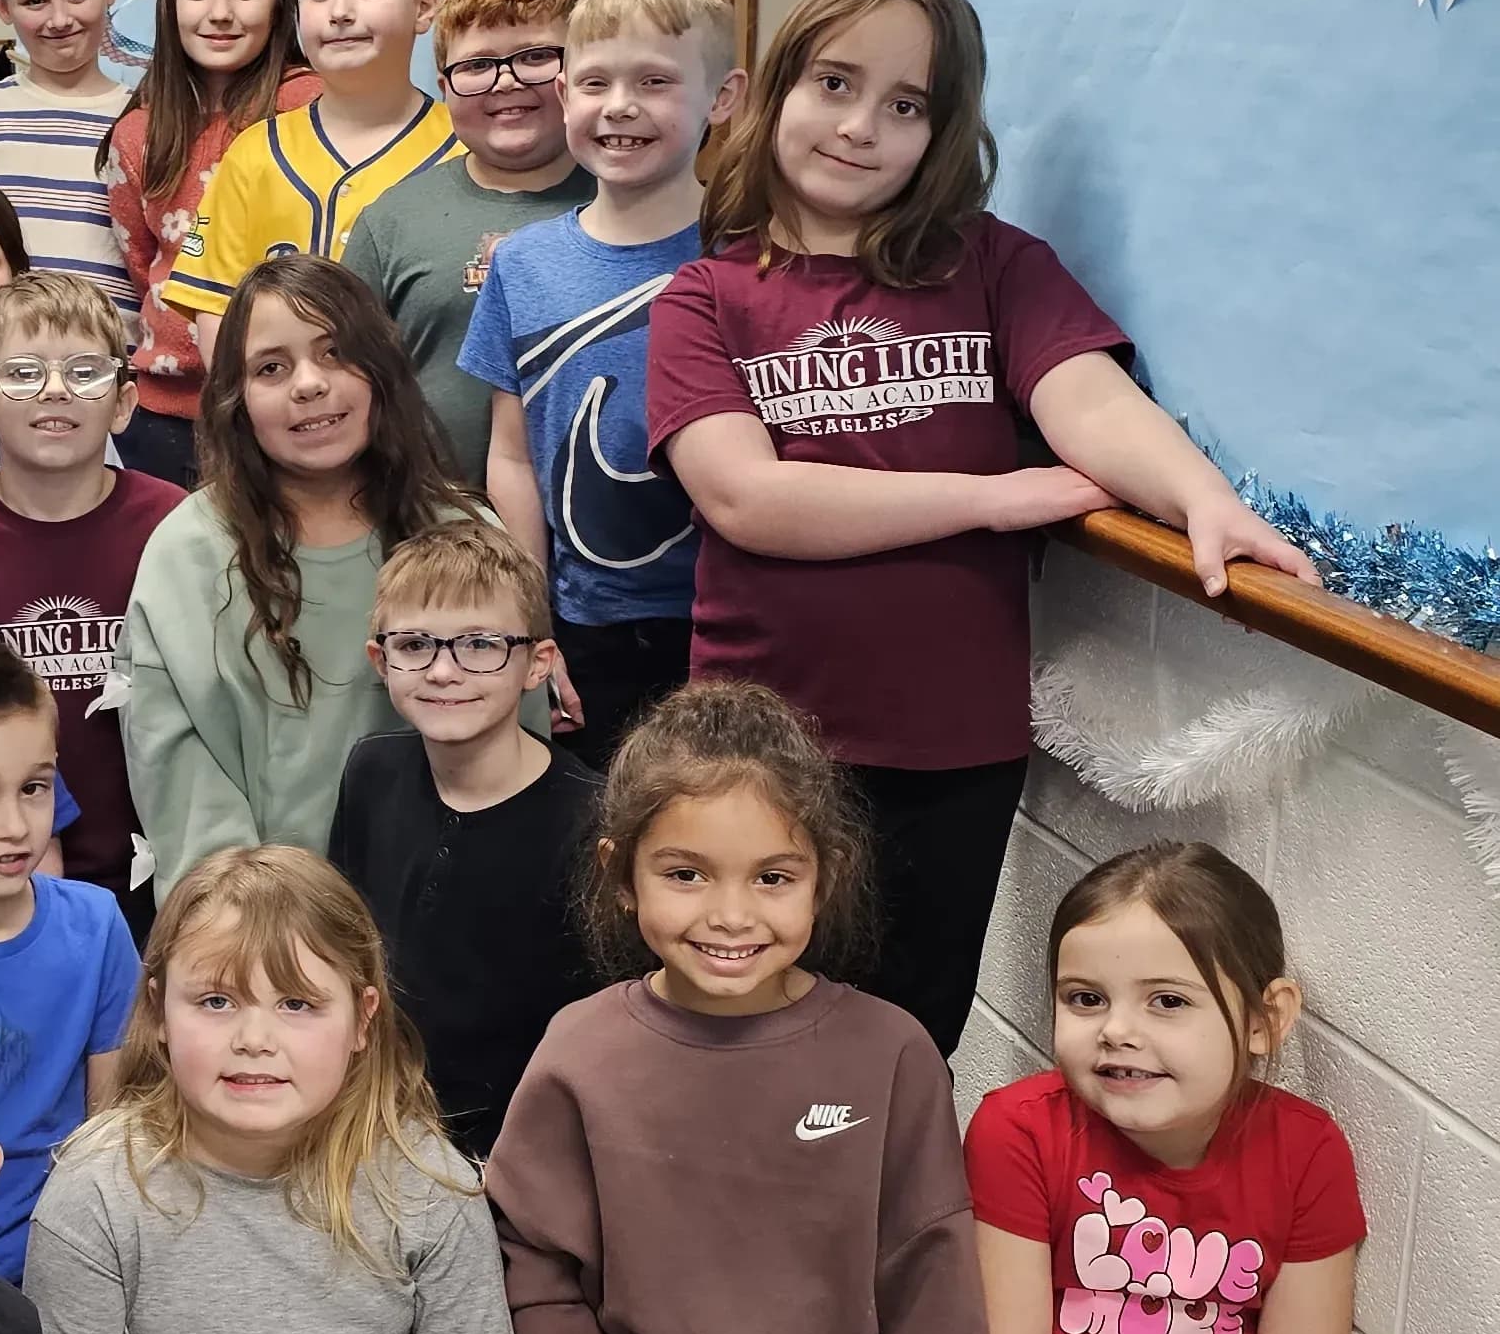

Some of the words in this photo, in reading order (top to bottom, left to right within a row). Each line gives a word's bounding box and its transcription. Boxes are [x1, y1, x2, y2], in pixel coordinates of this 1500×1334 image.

[744, 350, 867, 399] HINING
[875, 337, 991, 382] LIGHT
[763, 394, 855, 425] RISTIAN
[866, 380, 989, 409] ACADEMY
[811, 412, 898, 436] EAGLES
[49, 676, 93, 691] GLES
[806, 1104, 852, 1127] NIKE
[1073, 1213, 1265, 1303] LOVE
